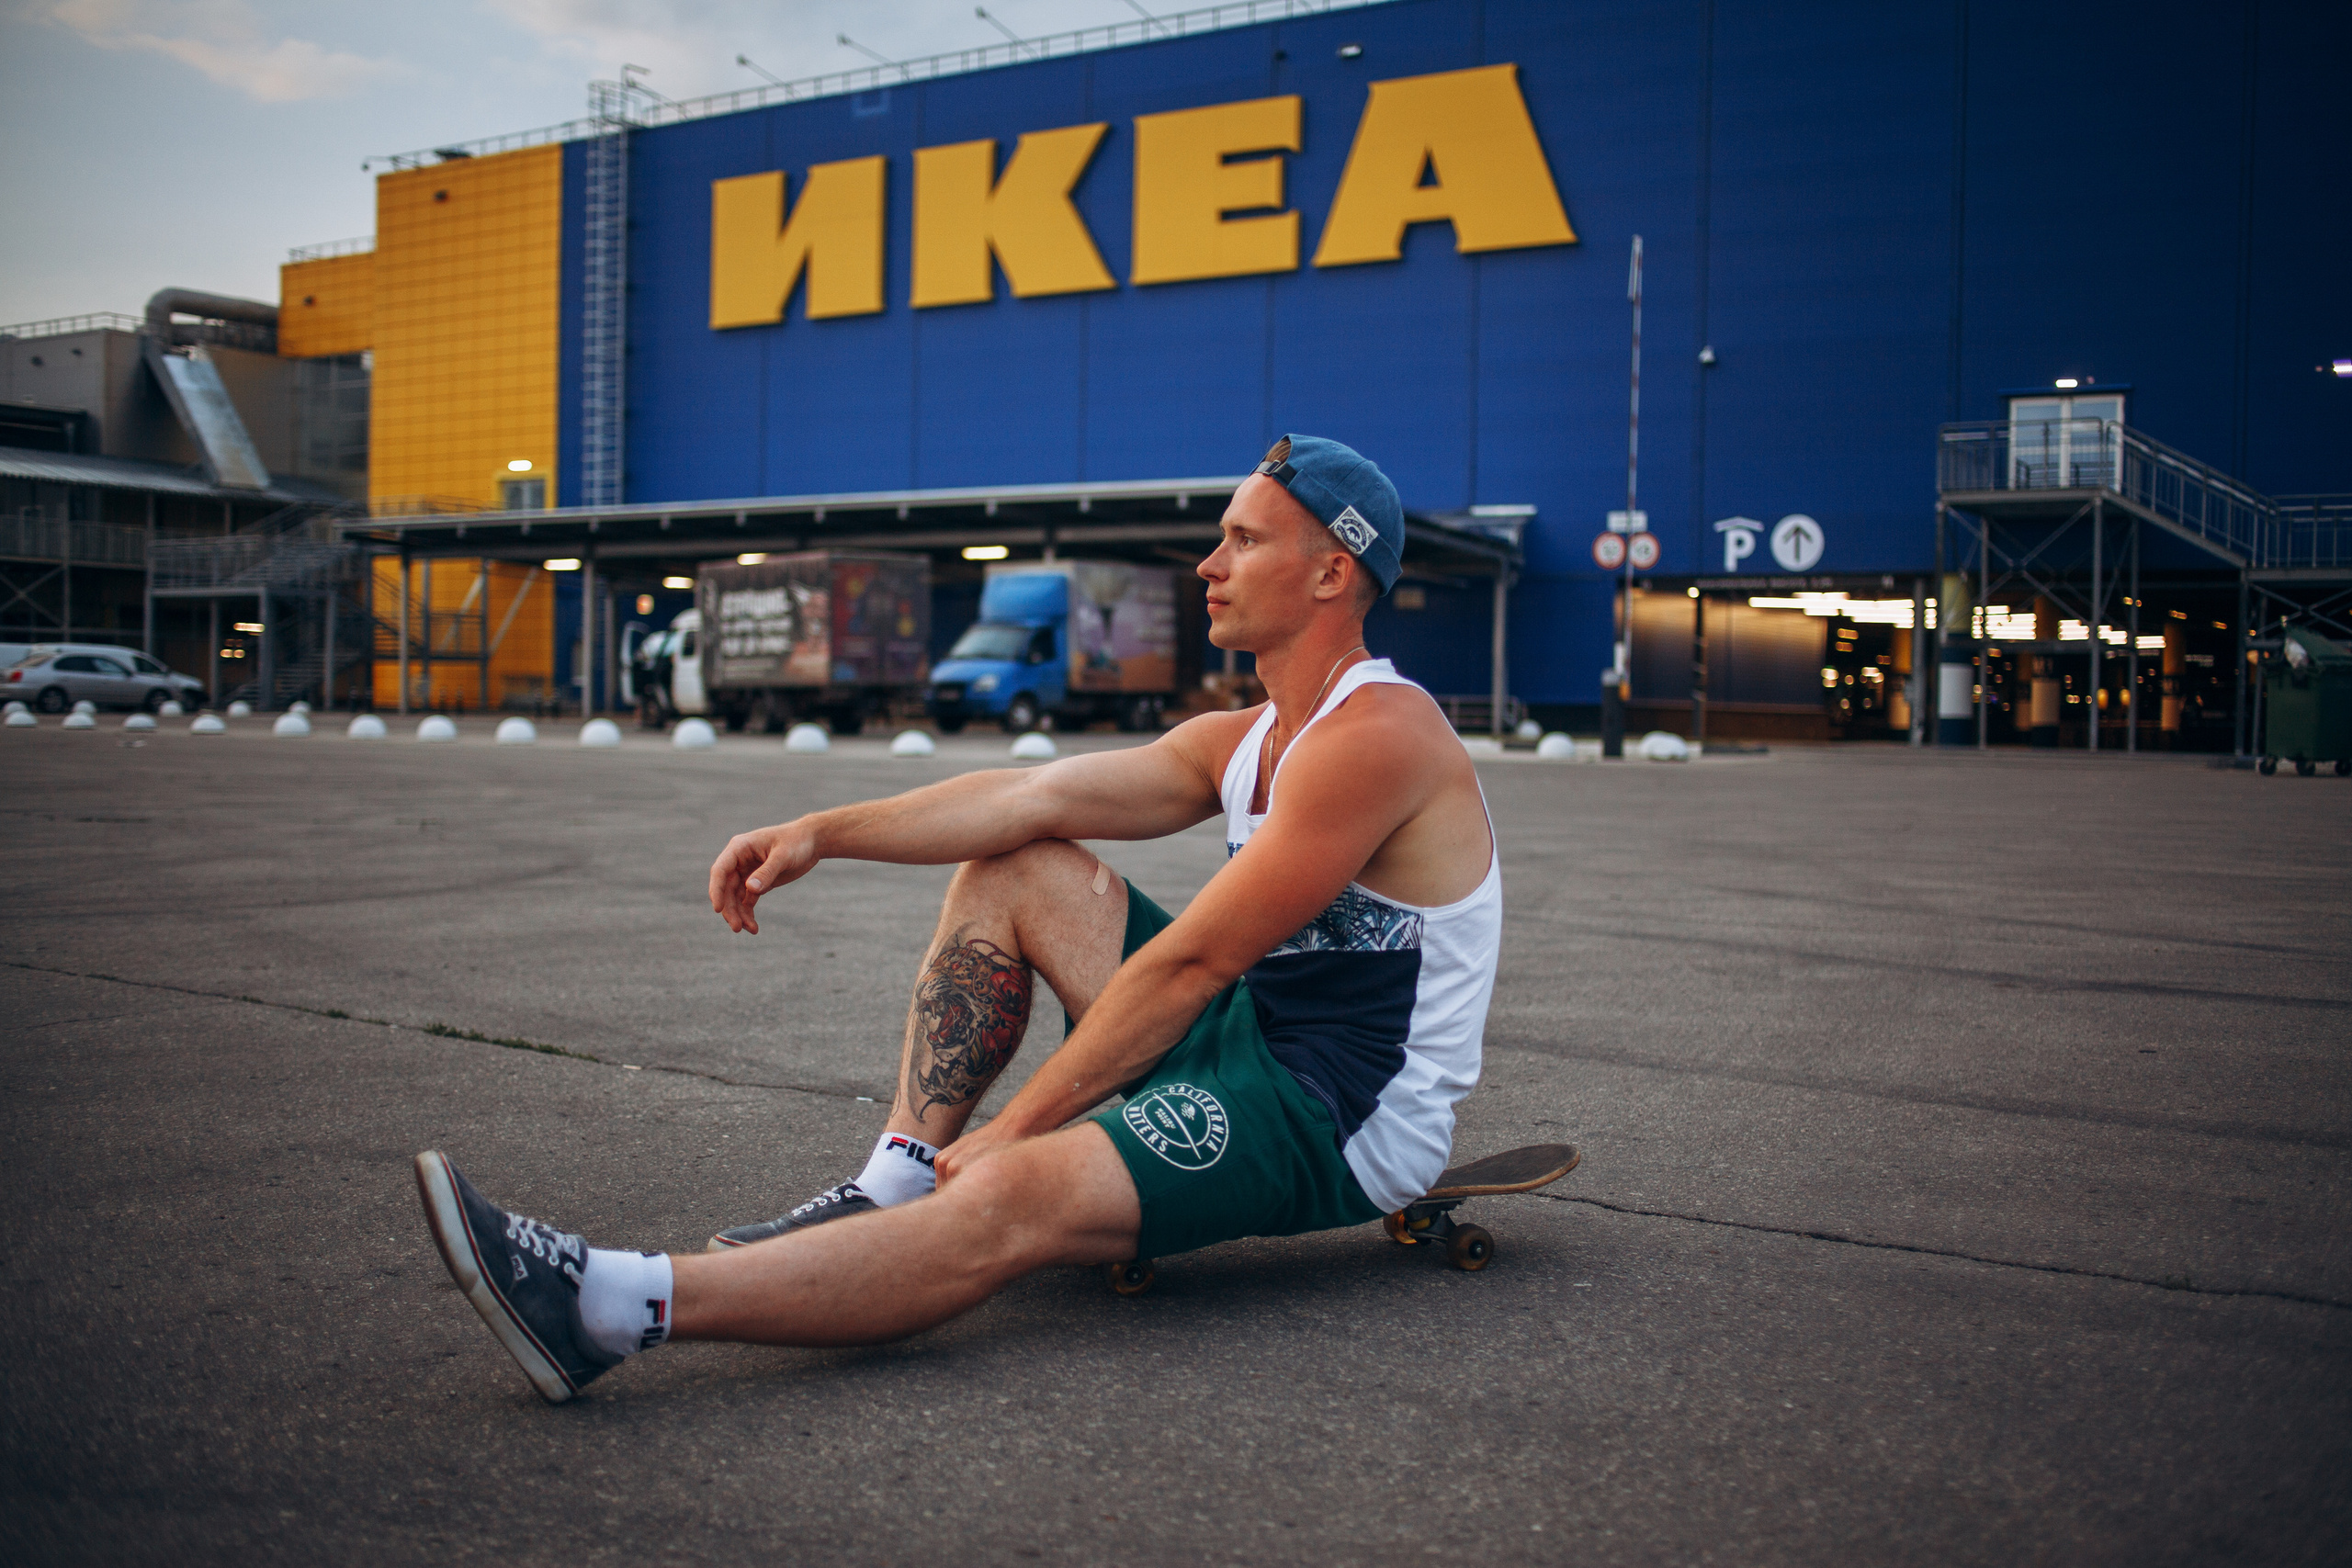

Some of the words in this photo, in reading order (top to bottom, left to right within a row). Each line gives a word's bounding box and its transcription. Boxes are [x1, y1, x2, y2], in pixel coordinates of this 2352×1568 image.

[708, 61, 1579, 331] ИКЕА
[1724, 528, 1756, 572] P
[1128, 1106, 1168, 1152] WATERS
[1154, 1111, 1170, 1129] POINT
[1157, 1108, 1176, 1129] MALIBU
[1169, 1085, 1225, 1152] CALIFORNIA
[886, 1136, 936, 1169] FIL
[512, 1258, 524, 1277] FILA
